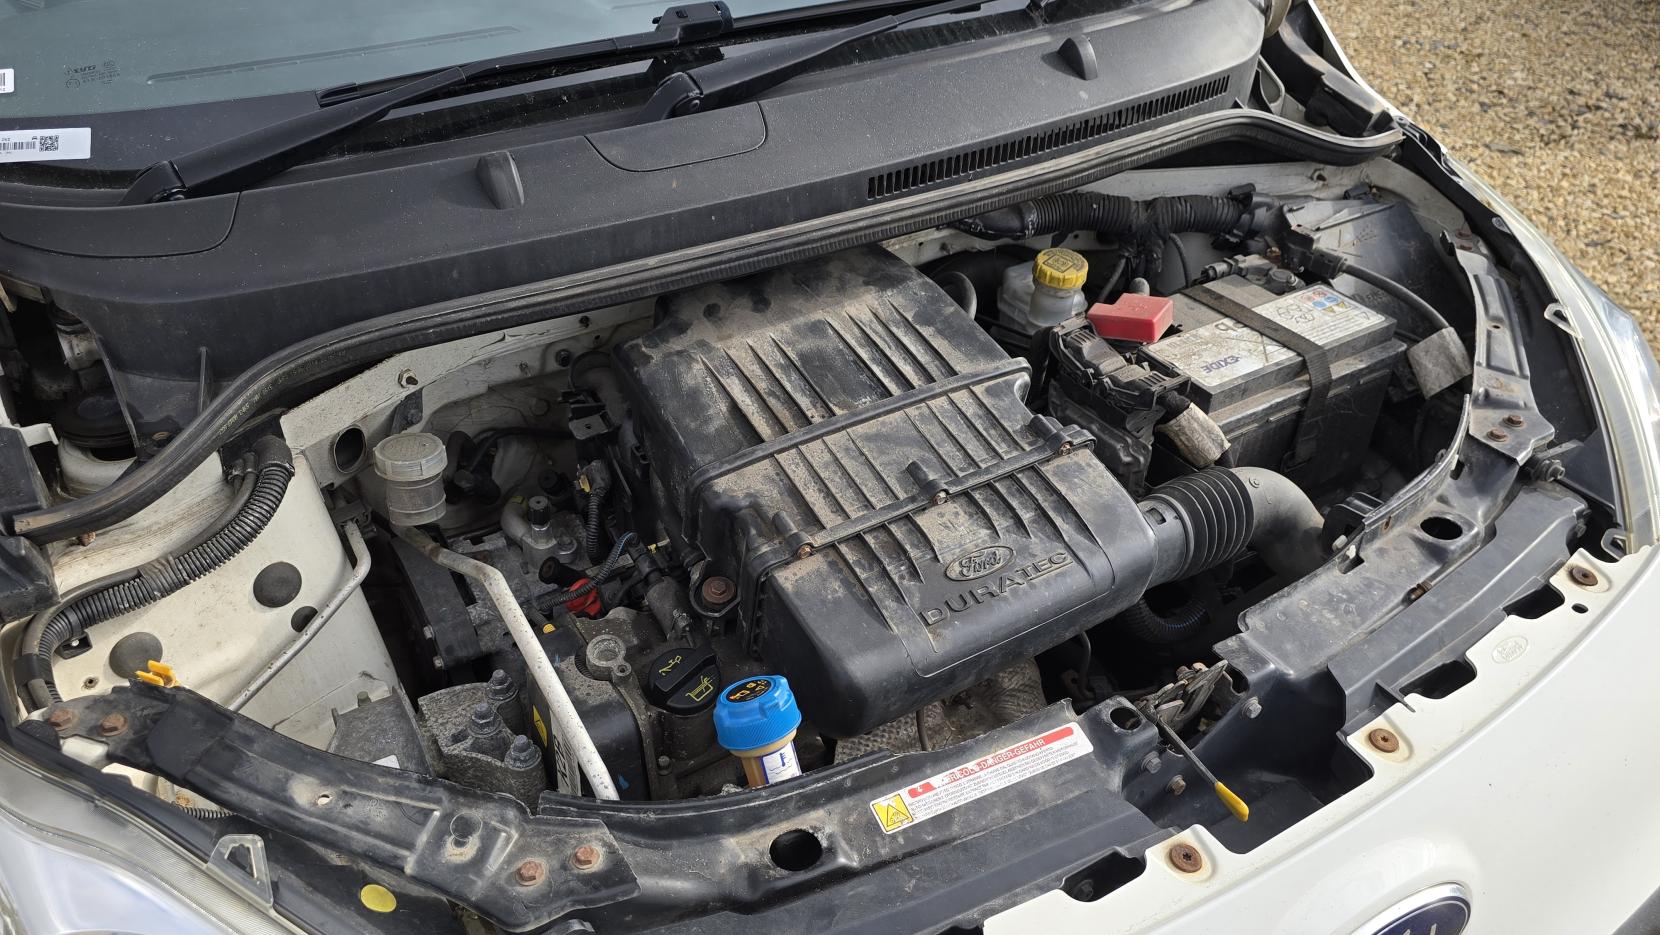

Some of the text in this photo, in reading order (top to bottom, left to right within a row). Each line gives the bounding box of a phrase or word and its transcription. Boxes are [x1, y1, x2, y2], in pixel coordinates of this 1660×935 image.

[1201, 355, 1242, 374] EXIDE
[959, 550, 1002, 578] Ford
[920, 553, 1073, 625] DURATEC
